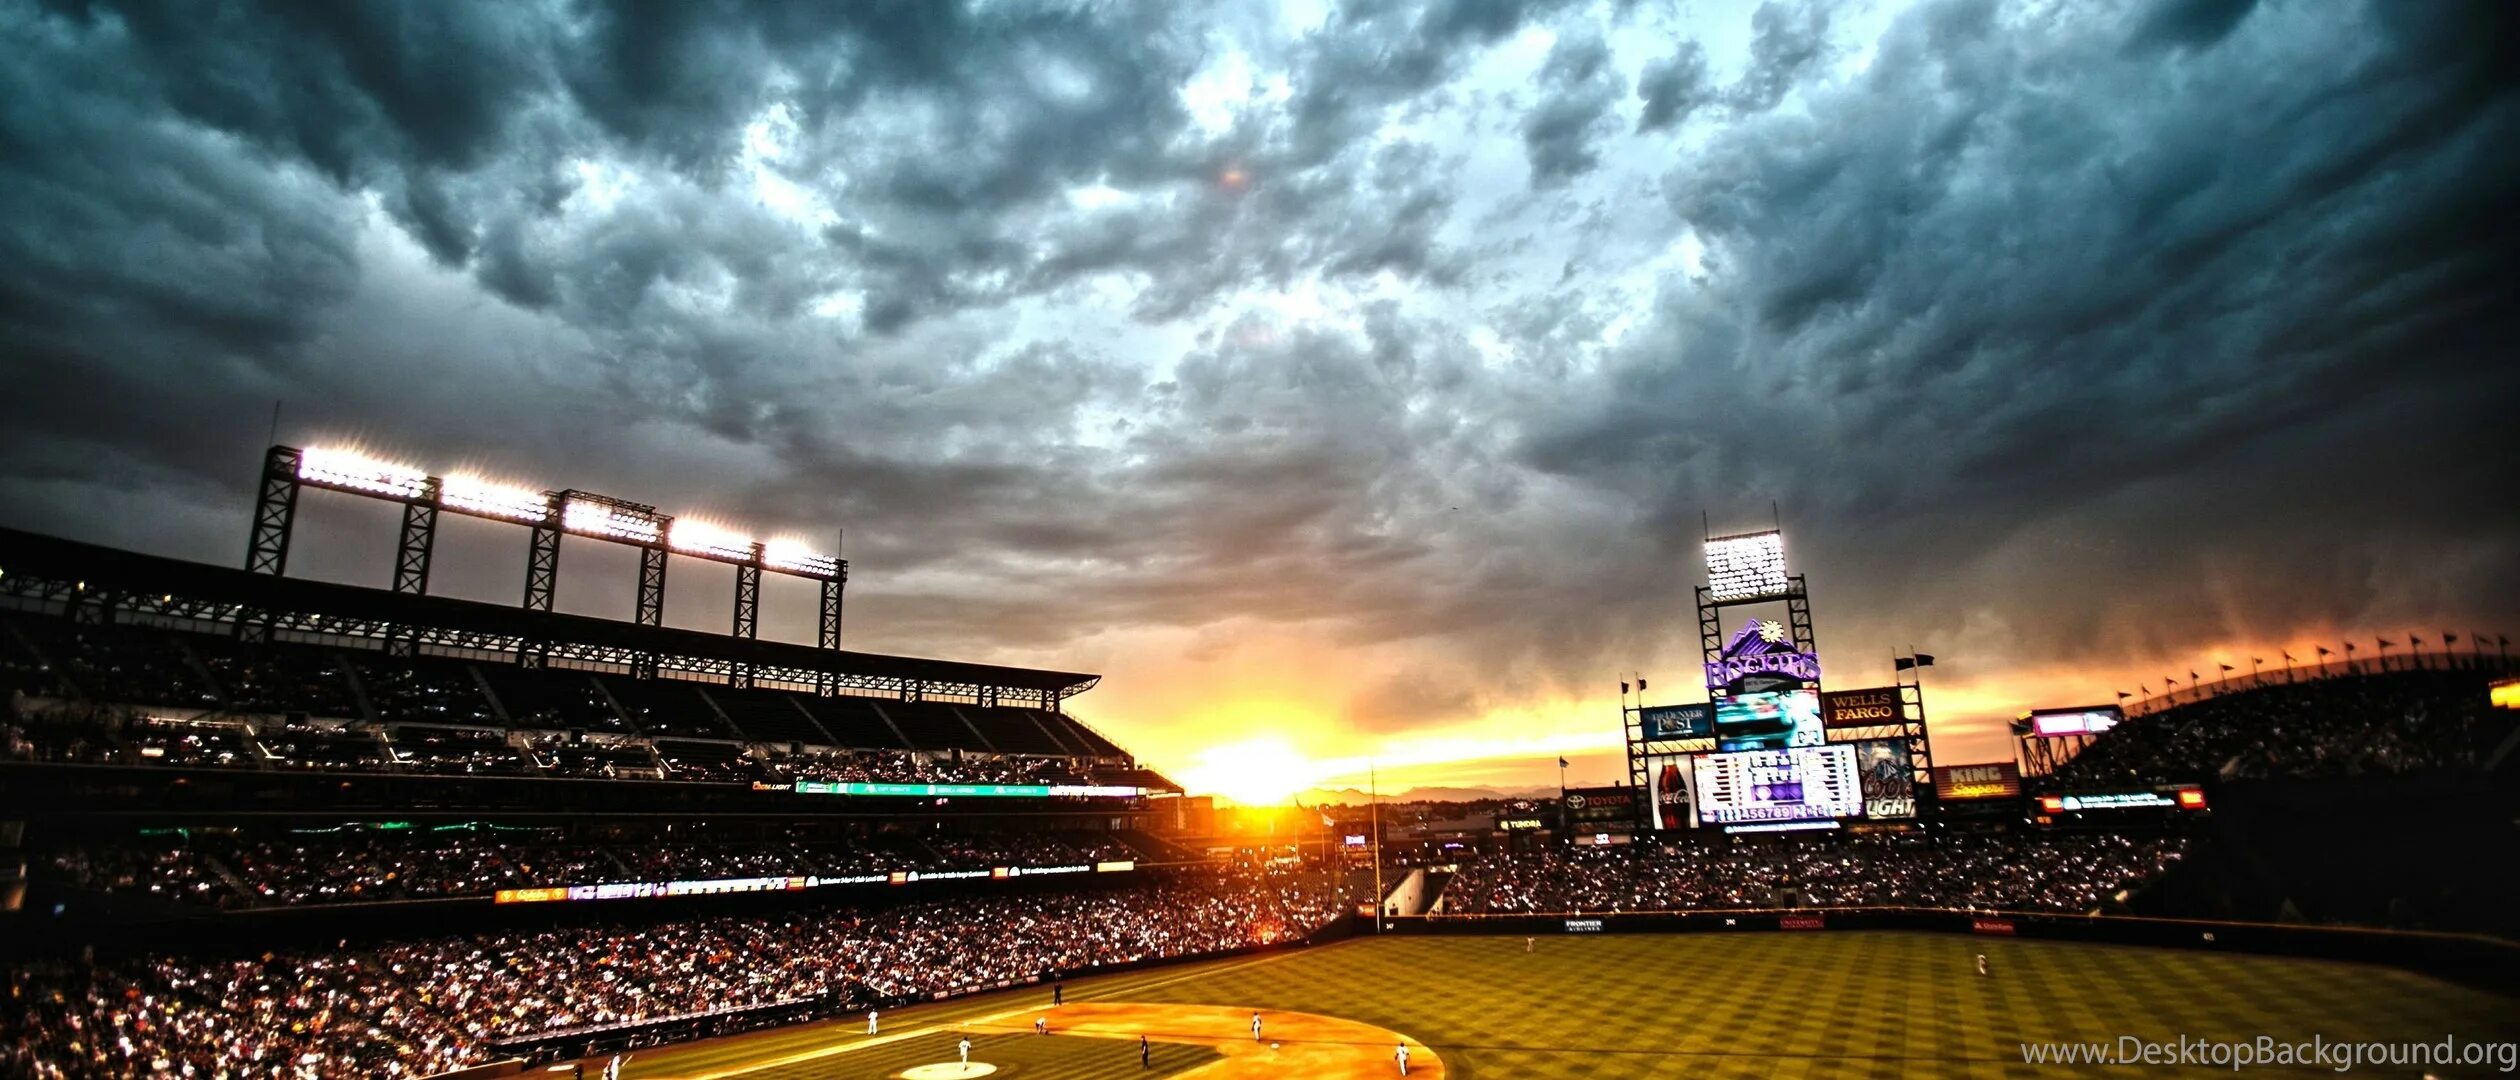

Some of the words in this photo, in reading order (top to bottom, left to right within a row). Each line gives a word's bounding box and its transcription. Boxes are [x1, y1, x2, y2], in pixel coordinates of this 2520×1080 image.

[1703, 652, 1821, 689] ROCKIES
[1832, 693, 1891, 708] WELLS
[1665, 709, 1704, 720] DENVER
[1835, 706, 1893, 720] FARGO
[1950, 767, 2002, 783] KING
[1952, 783, 2005, 797] Soopers
[1587, 795, 1631, 807] TOYOTA
[1866, 799, 1916, 817] LIGHT
[1510, 820, 1542, 829] TUNDRA
